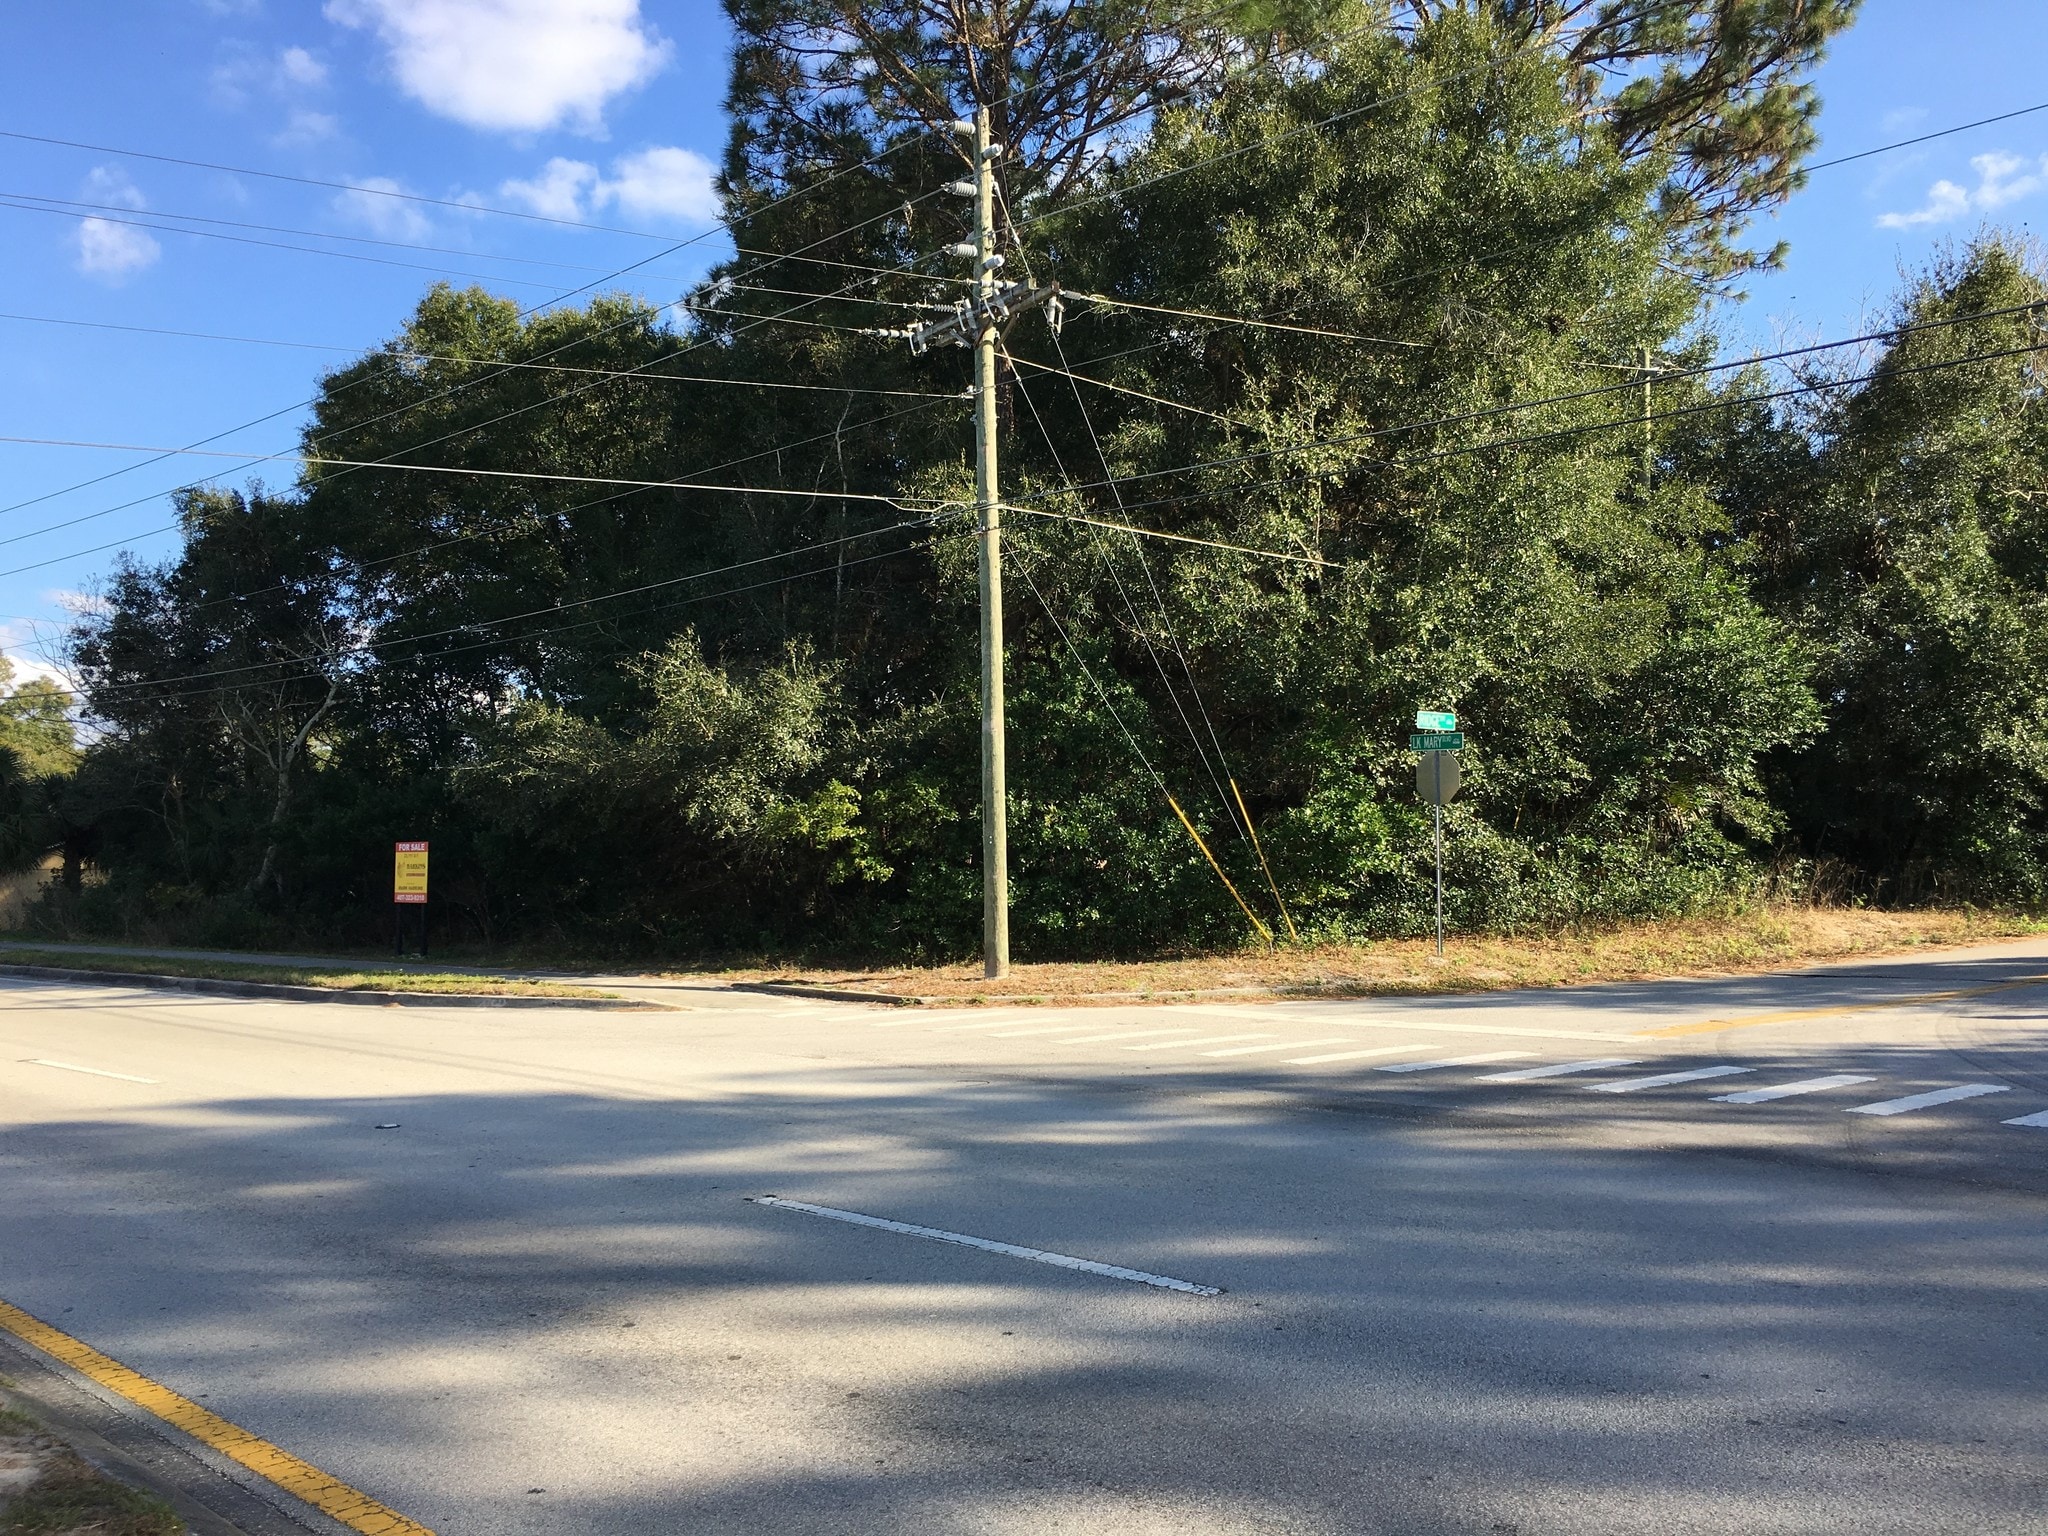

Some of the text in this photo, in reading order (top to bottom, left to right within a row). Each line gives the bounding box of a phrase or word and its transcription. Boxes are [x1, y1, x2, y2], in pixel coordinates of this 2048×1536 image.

[1412, 736, 1422, 749] LK
[1423, 735, 1442, 749] MARY
[398, 843, 425, 851] FOR SALE
